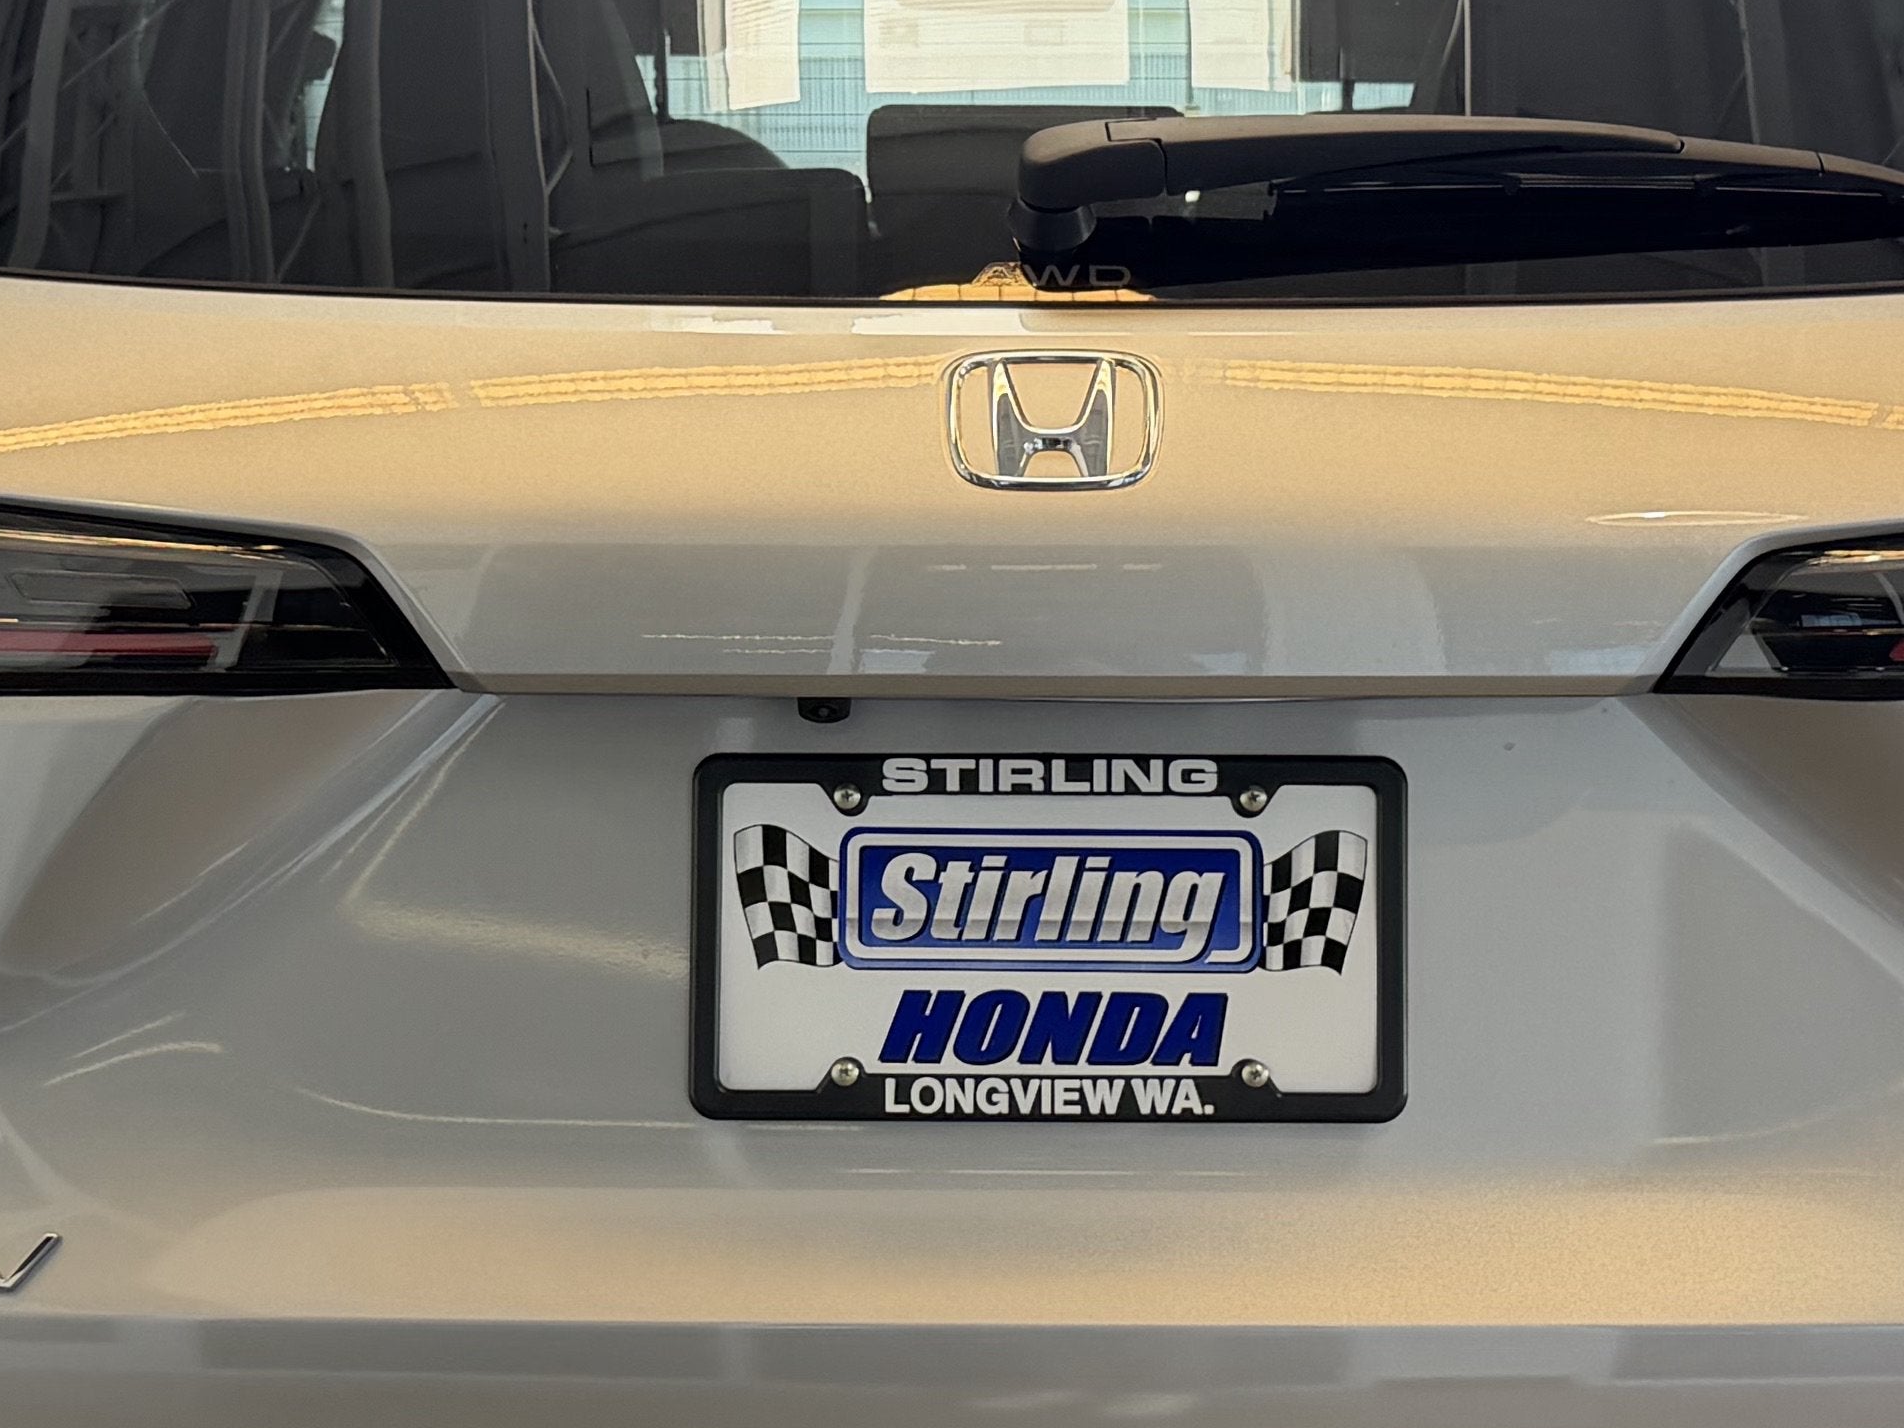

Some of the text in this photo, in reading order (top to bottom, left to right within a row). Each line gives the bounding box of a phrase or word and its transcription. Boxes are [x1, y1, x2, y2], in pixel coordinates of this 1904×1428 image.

[881, 757, 1219, 794] STIRLING
[870, 851, 1227, 963] Stirling
[877, 988, 1229, 1067] HONDA
[884, 1076, 1215, 1116] LONGVIEW WA.
